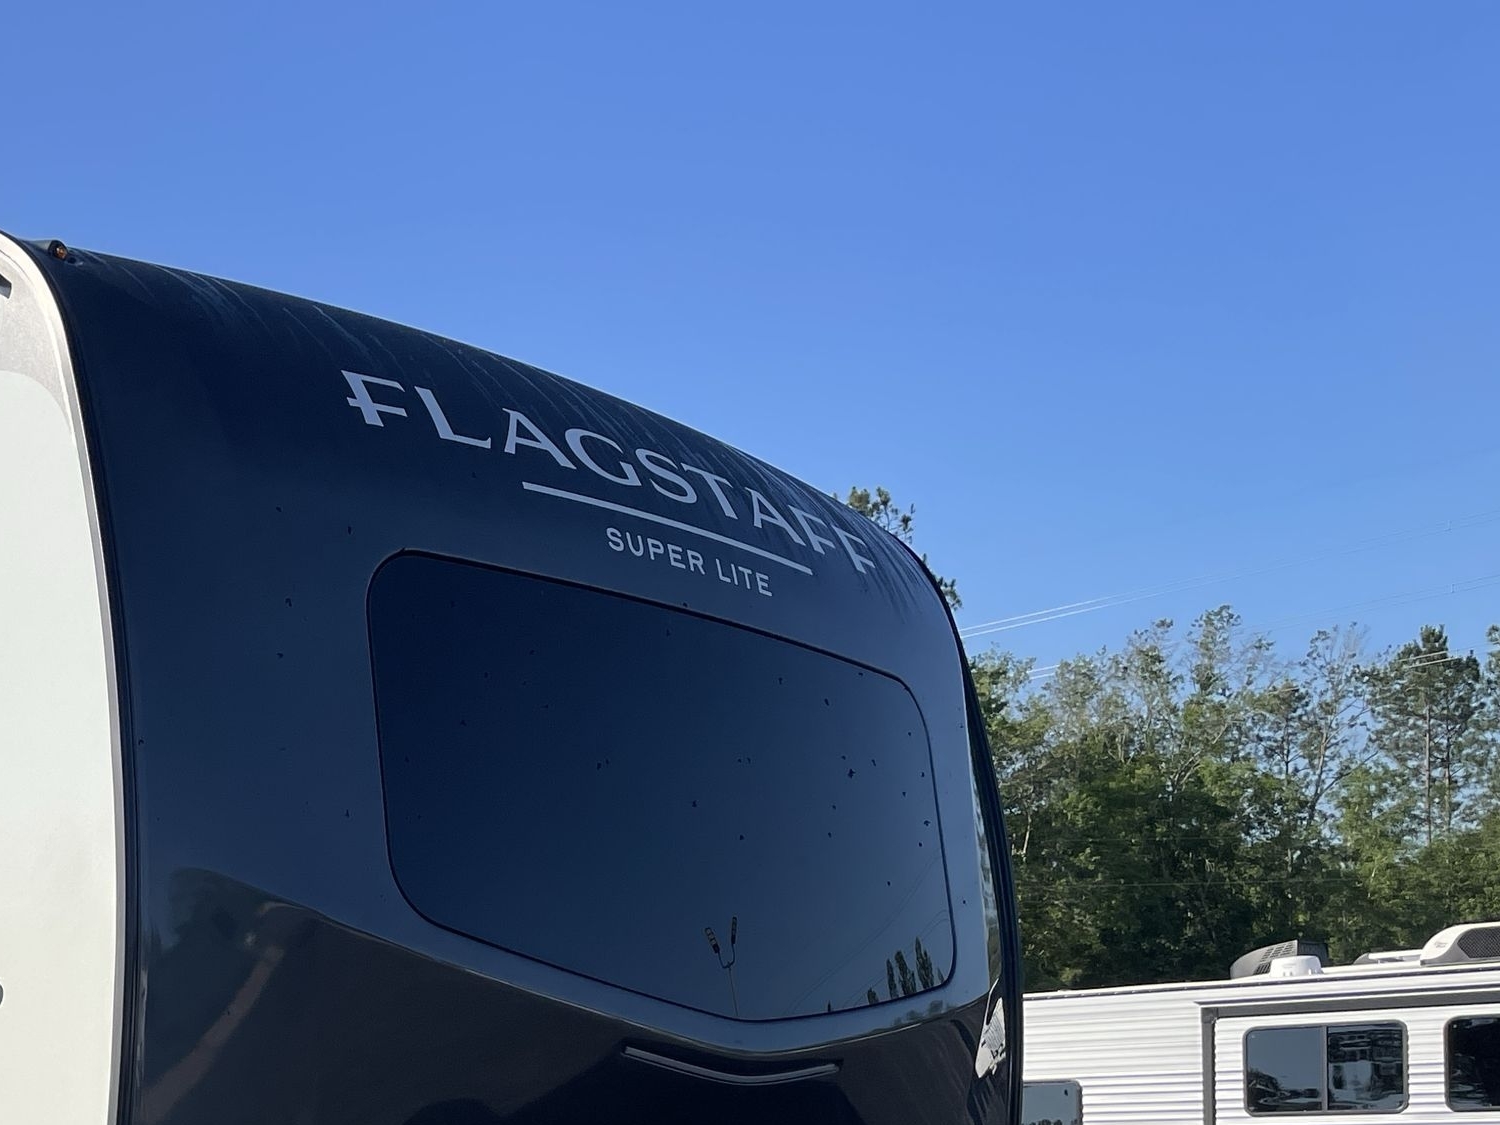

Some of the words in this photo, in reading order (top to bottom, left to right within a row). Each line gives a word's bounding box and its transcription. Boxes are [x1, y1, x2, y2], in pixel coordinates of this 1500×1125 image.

[340, 369, 876, 575] FLAGSTAFF
[606, 526, 706, 576] SUPER
[716, 557, 773, 598] LITE
